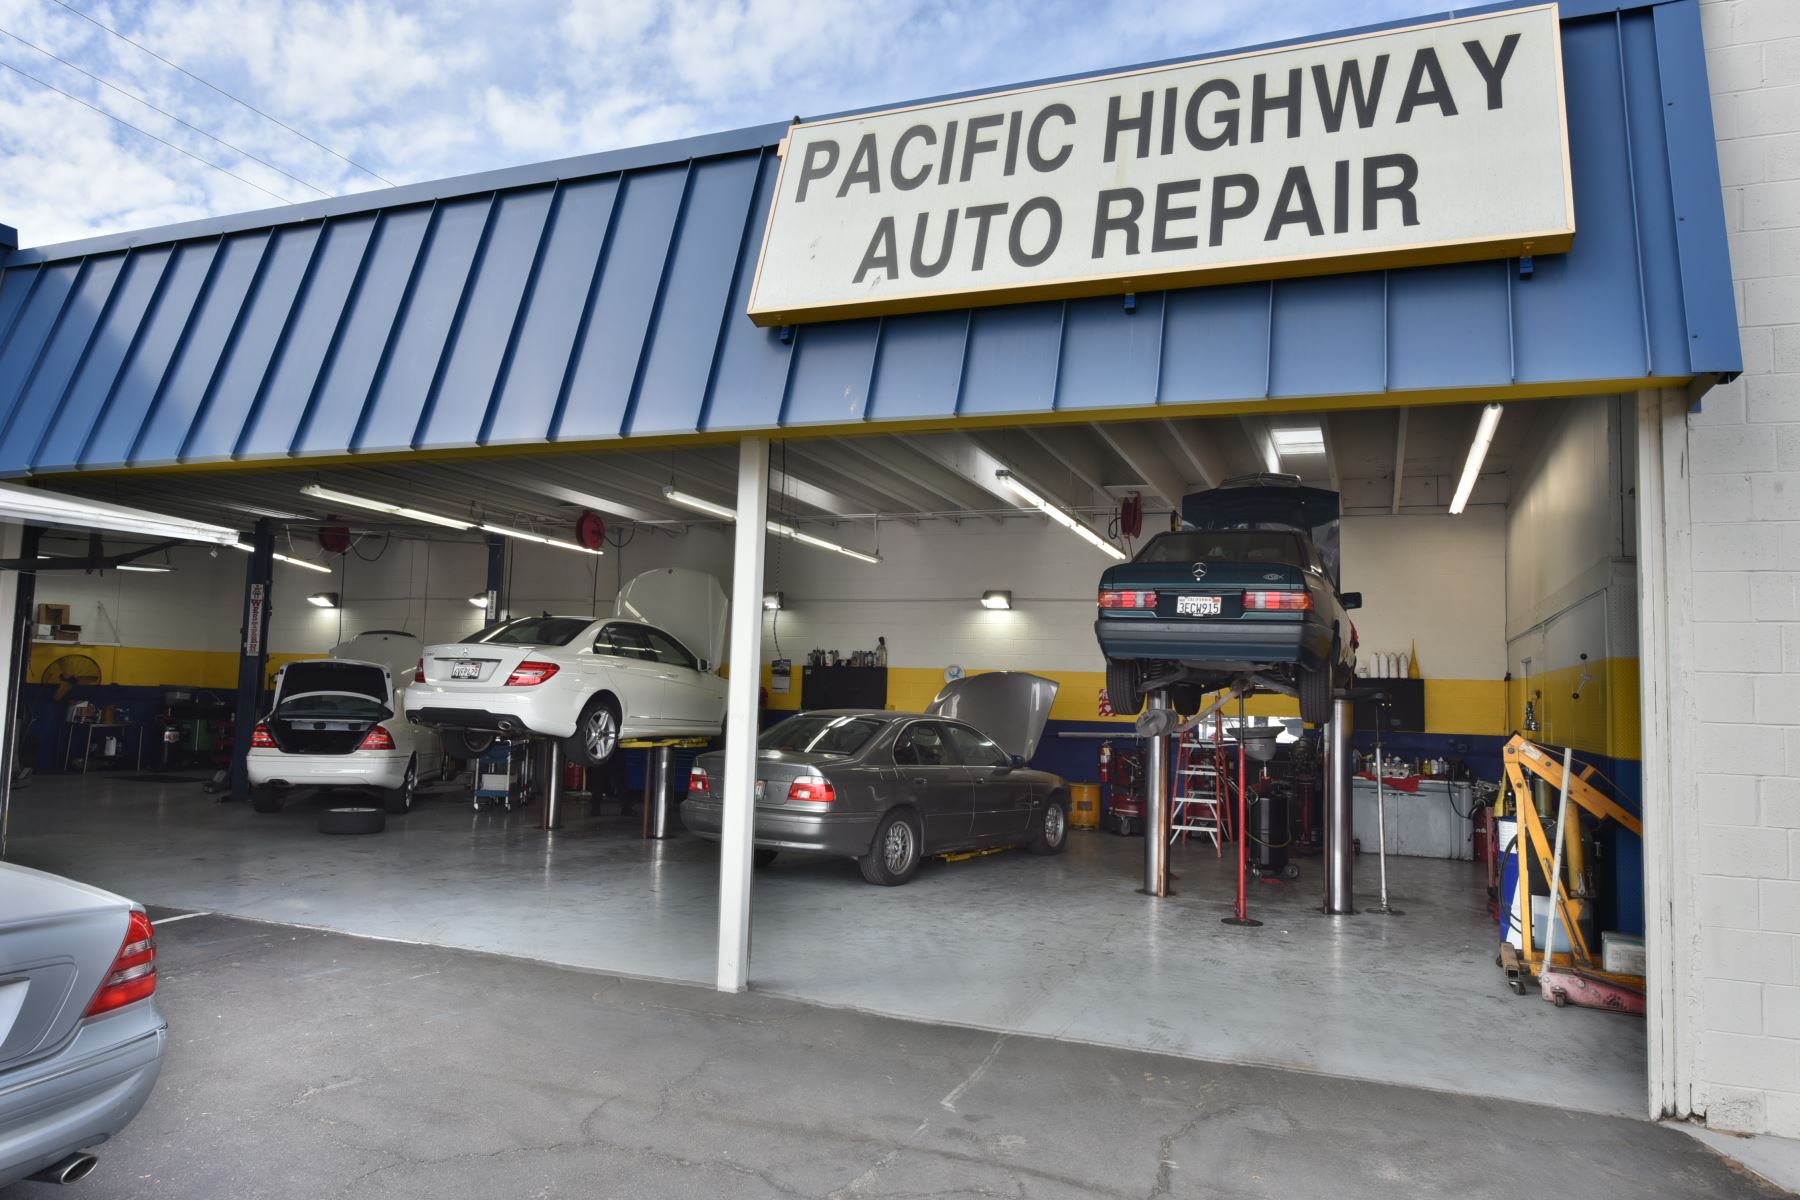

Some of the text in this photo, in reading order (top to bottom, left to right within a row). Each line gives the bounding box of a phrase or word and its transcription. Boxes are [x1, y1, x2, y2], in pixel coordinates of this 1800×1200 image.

[795, 33, 1522, 203] PACIFIC HIGHWAY
[852, 153, 1421, 284] AUTO REPAIR
[1179, 602, 1219, 614] 3ECW915
